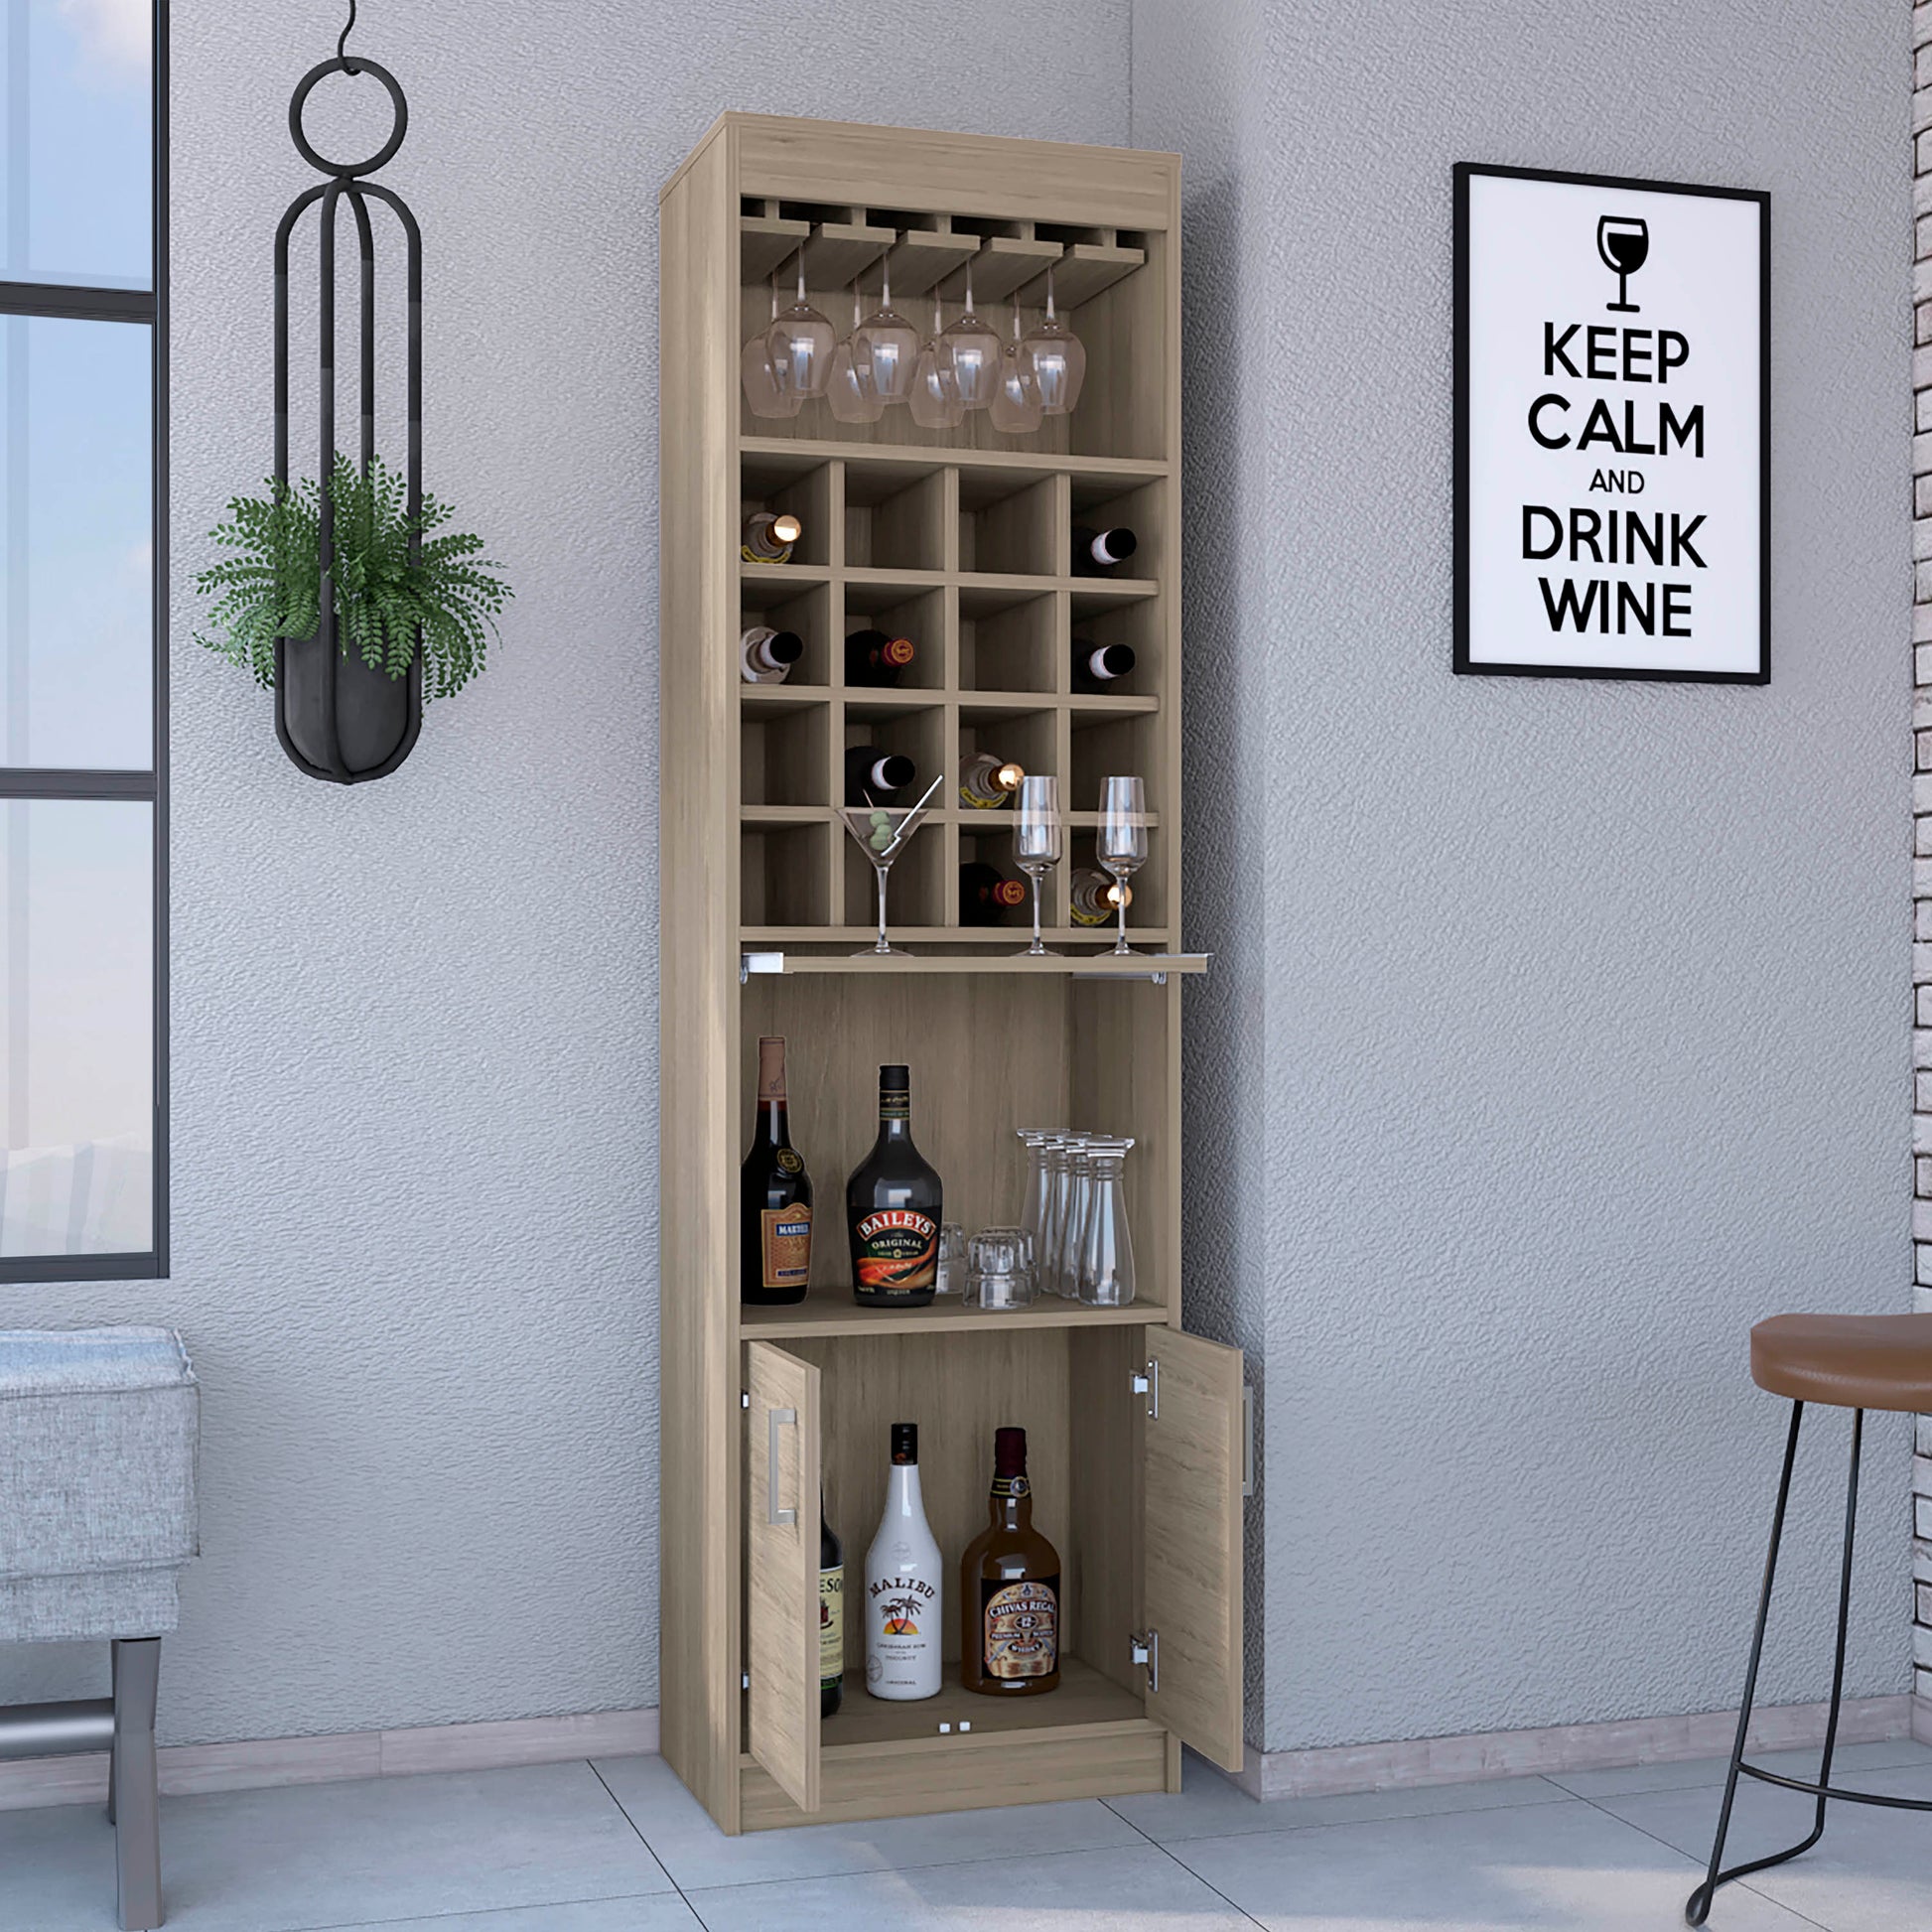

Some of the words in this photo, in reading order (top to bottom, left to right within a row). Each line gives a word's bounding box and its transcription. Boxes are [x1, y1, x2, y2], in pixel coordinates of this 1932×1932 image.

[1544, 322, 1690, 384] KEEP
[1527, 393, 1705, 459] CALM
[1588, 468, 1645, 494] AND
[1522, 504, 1708, 568] DRINK
[1537, 577, 1692, 637] WINE
[860, 1212, 932, 1235] BAILEYS
[872, 1238, 922, 1249] ORIGINAL
[869, 1577, 935, 1598] MALIBU
[989, 1601, 1028, 1618] CHIVAS
